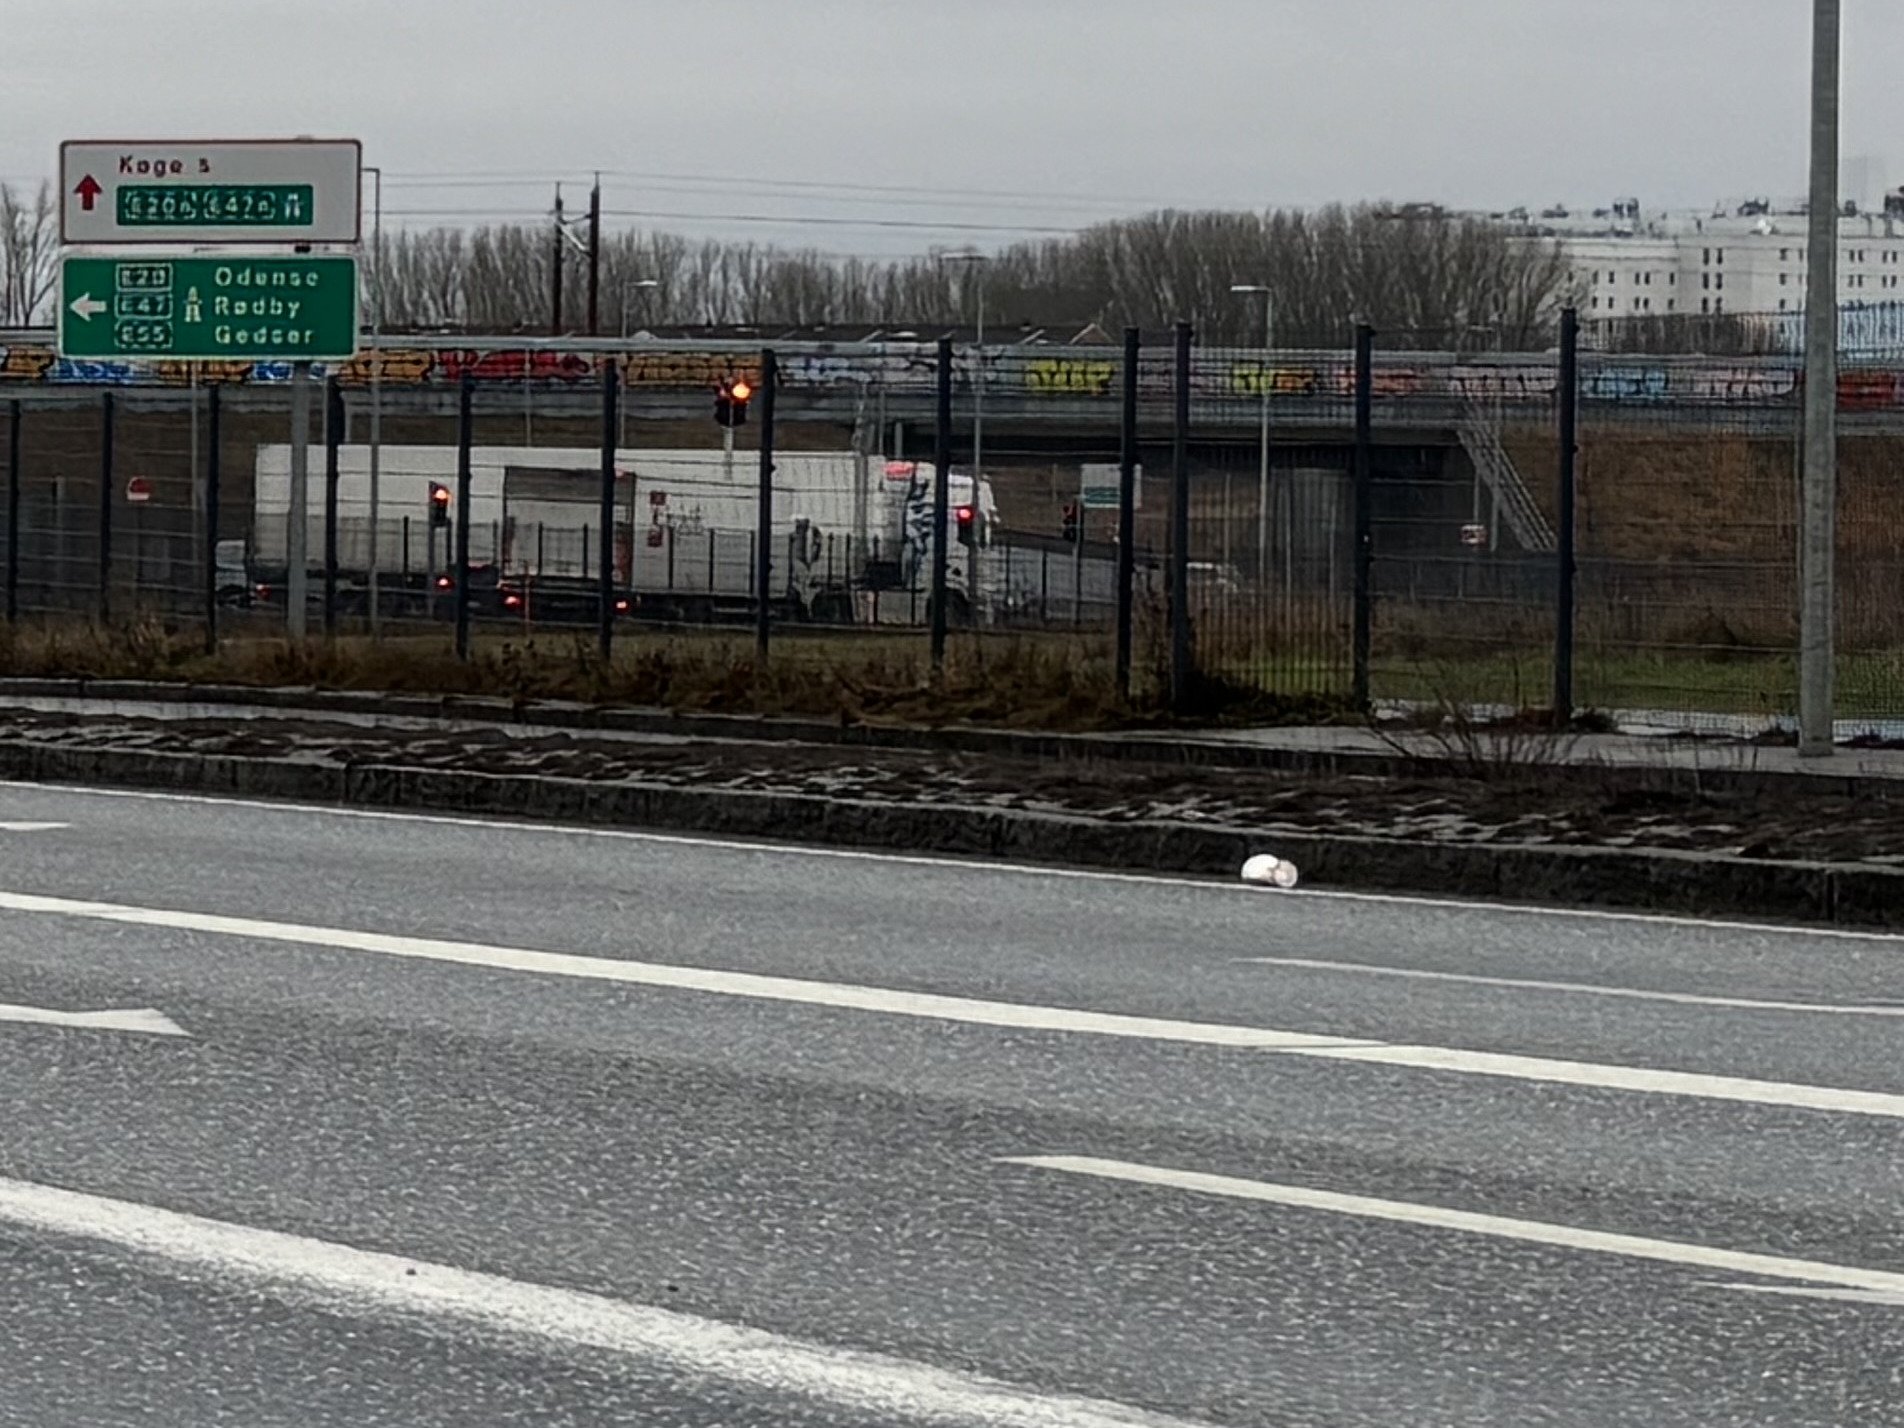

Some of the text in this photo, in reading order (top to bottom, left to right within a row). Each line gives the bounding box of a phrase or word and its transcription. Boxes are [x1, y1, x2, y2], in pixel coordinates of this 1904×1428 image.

[118, 155, 184, 178] Køge
[121, 270, 166, 286] E20
[214, 266, 319, 287] Odense
[121, 295, 165, 312] E47
[214, 296, 300, 319] Rødby
[121, 326, 165, 342] E55
[214, 325, 314, 344] Gedser
